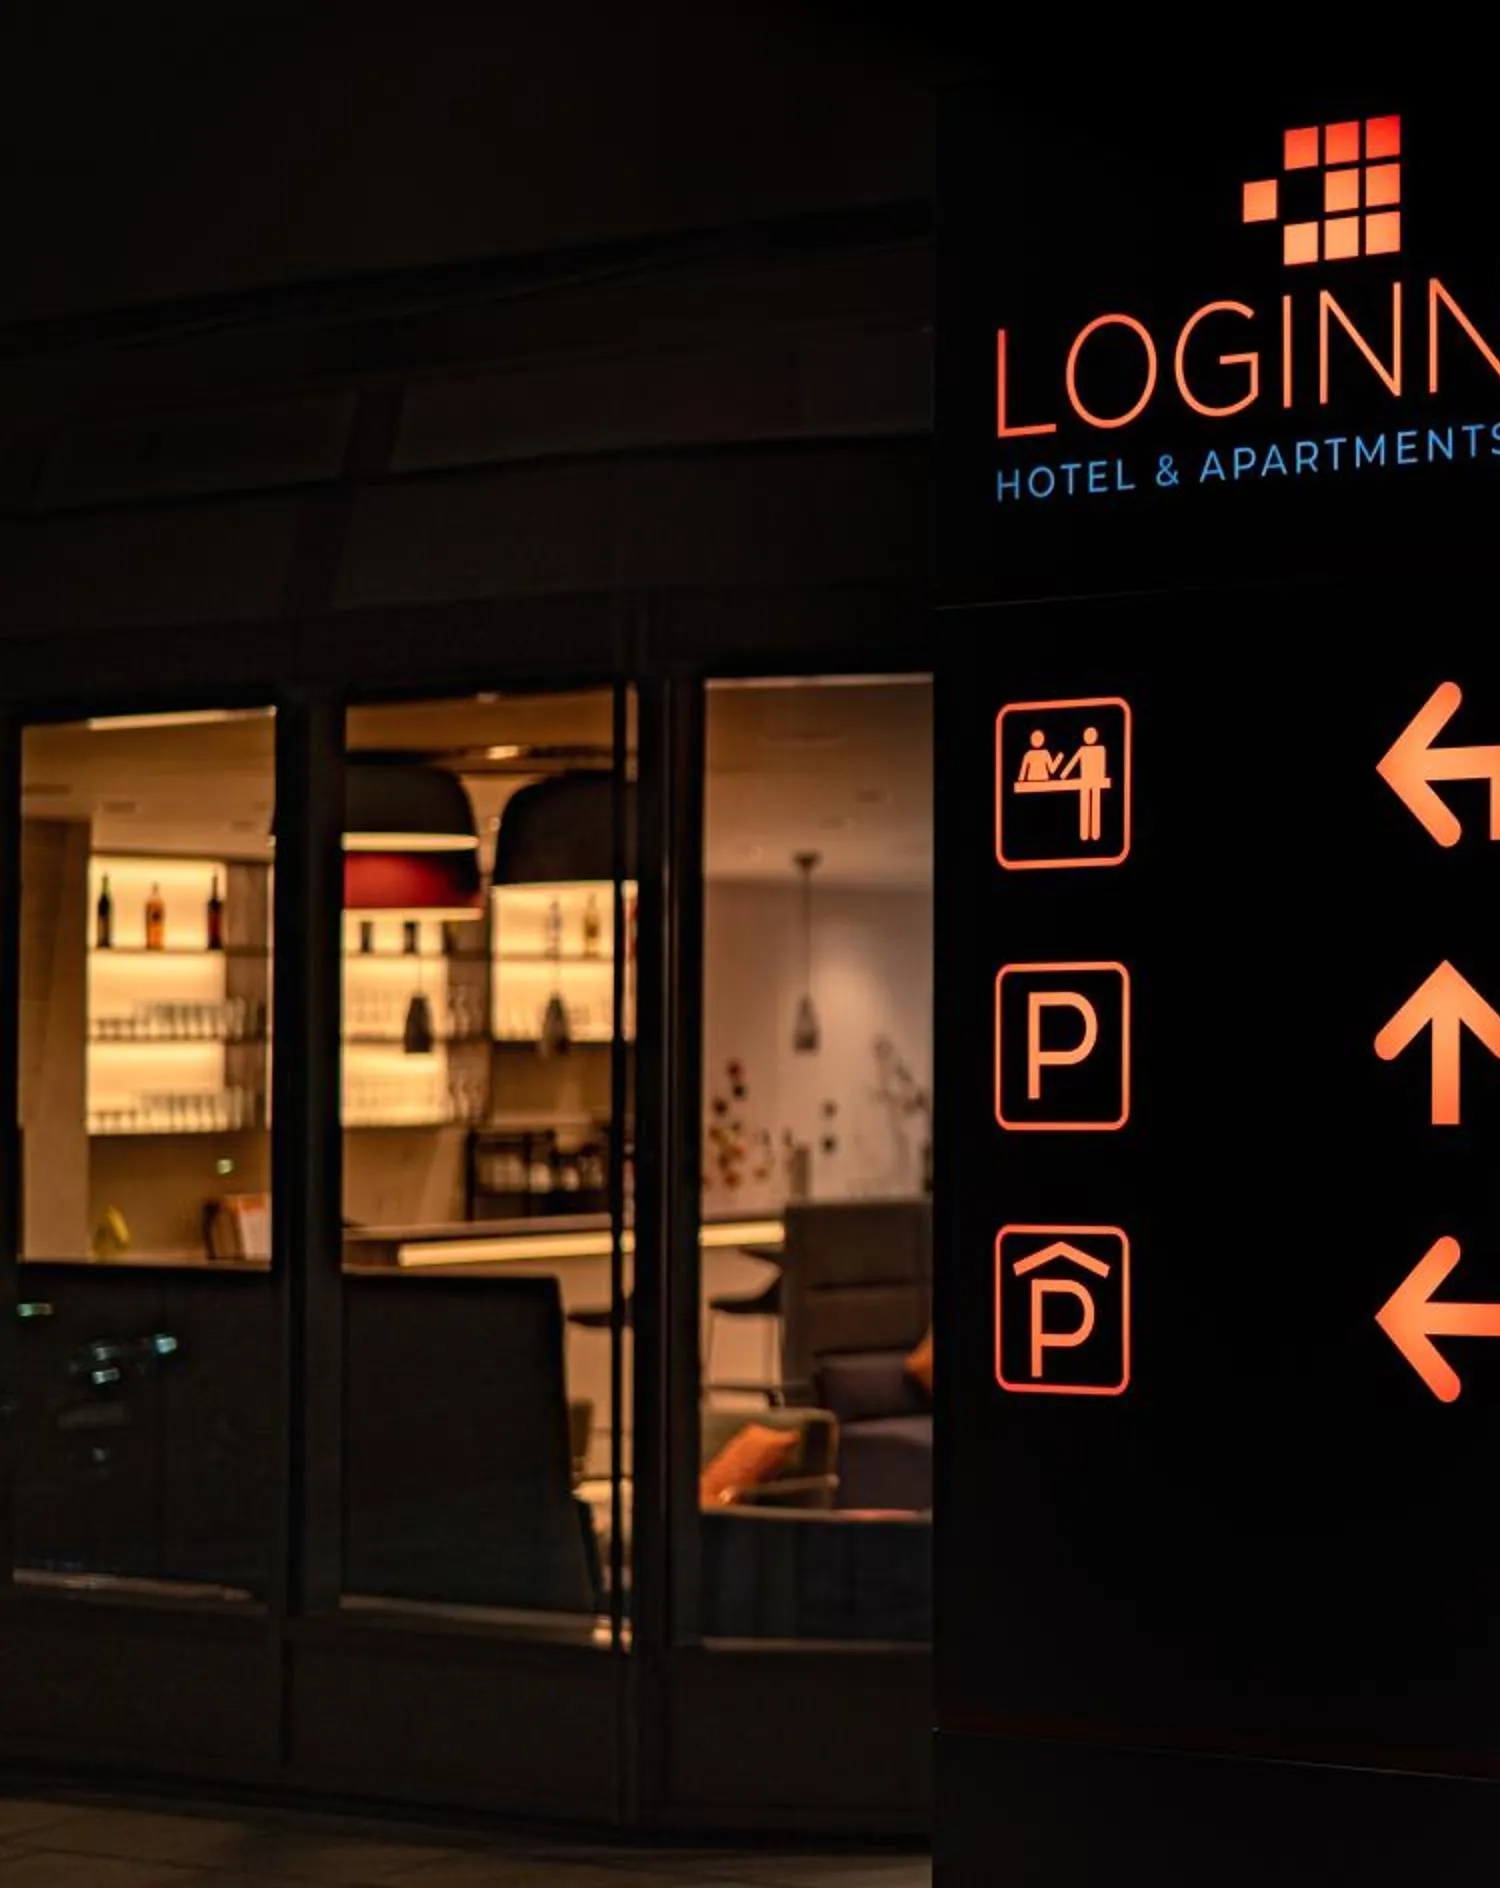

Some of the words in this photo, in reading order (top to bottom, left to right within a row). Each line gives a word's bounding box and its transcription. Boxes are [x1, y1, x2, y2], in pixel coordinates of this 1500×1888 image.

[997, 459, 1136, 501] HOTEL
[1155, 454, 1179, 487] &
[1028, 992, 1098, 1099] P
[1031, 1279, 1095, 1378] P
